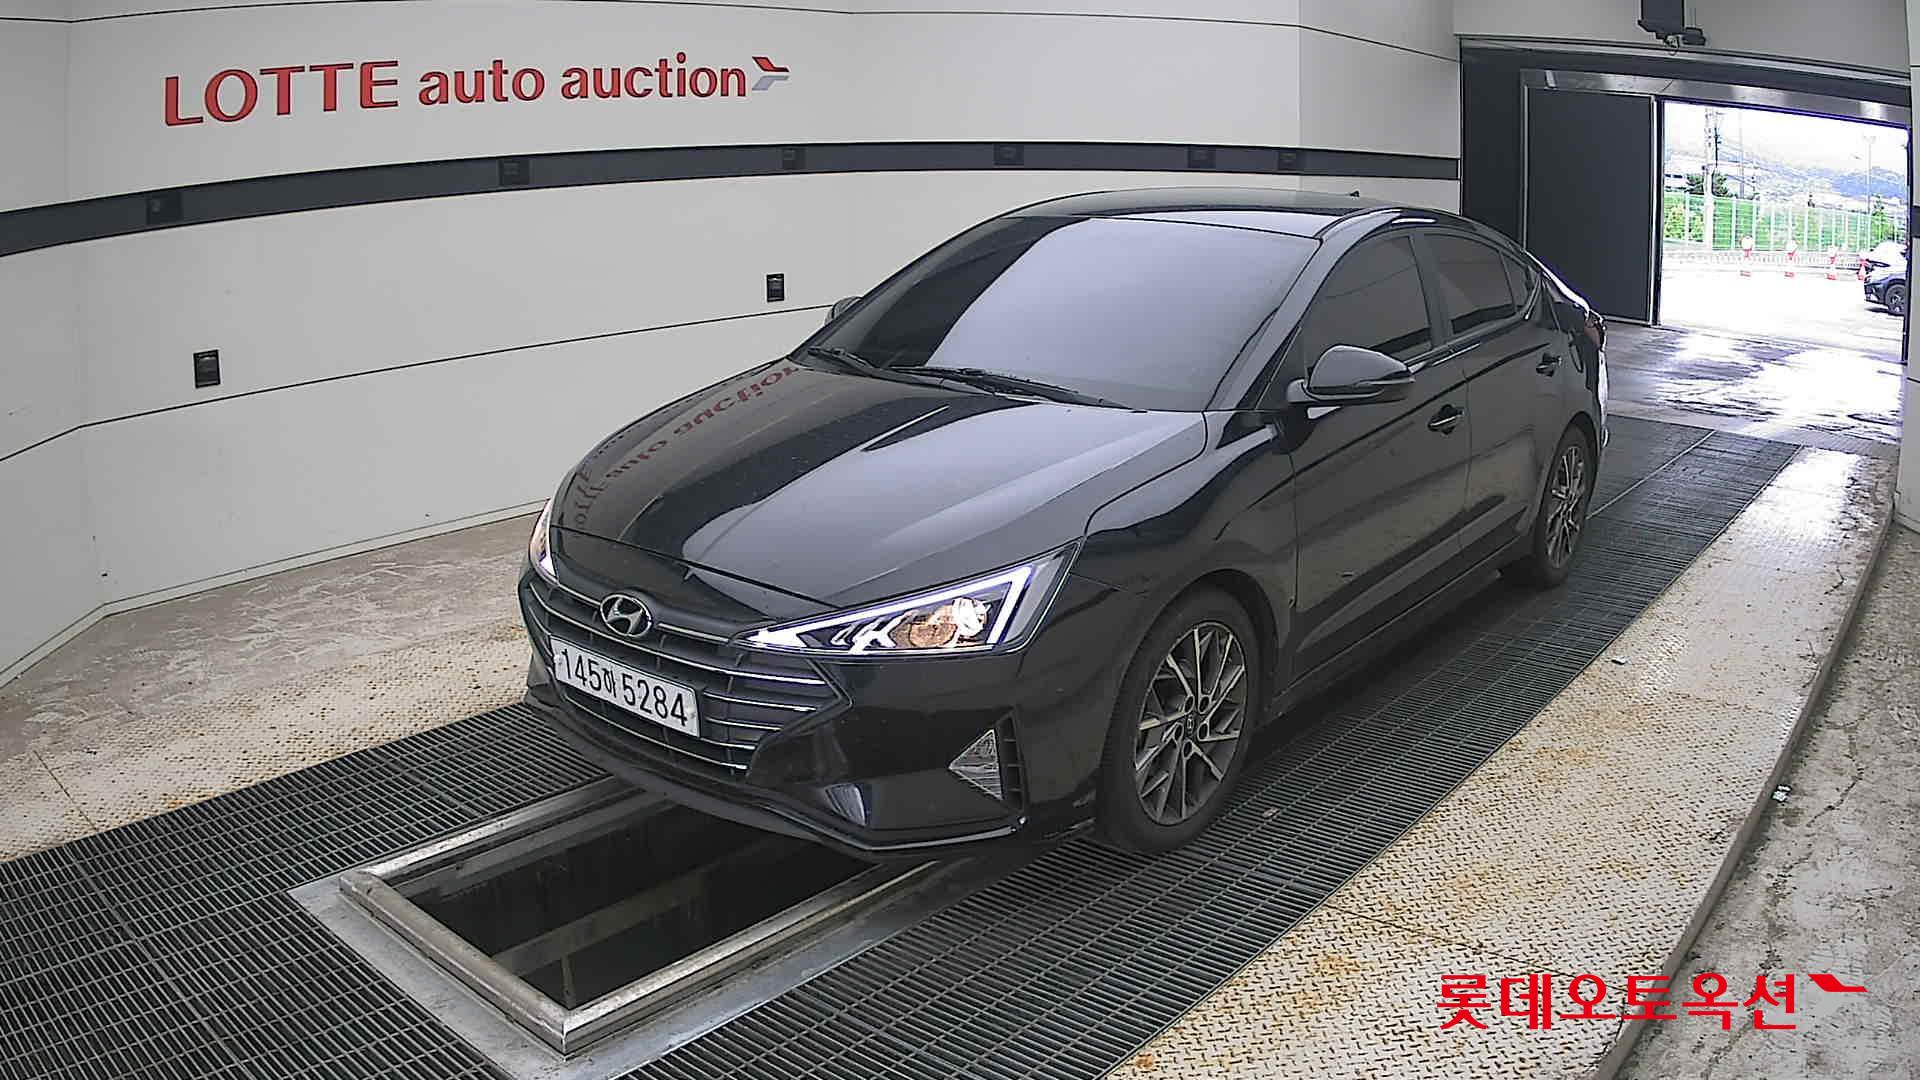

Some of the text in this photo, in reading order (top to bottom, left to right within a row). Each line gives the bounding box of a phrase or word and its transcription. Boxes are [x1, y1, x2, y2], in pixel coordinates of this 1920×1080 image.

[164, 51, 748, 127] LOTTE auto auction
[621, 672, 688, 728] 5284
